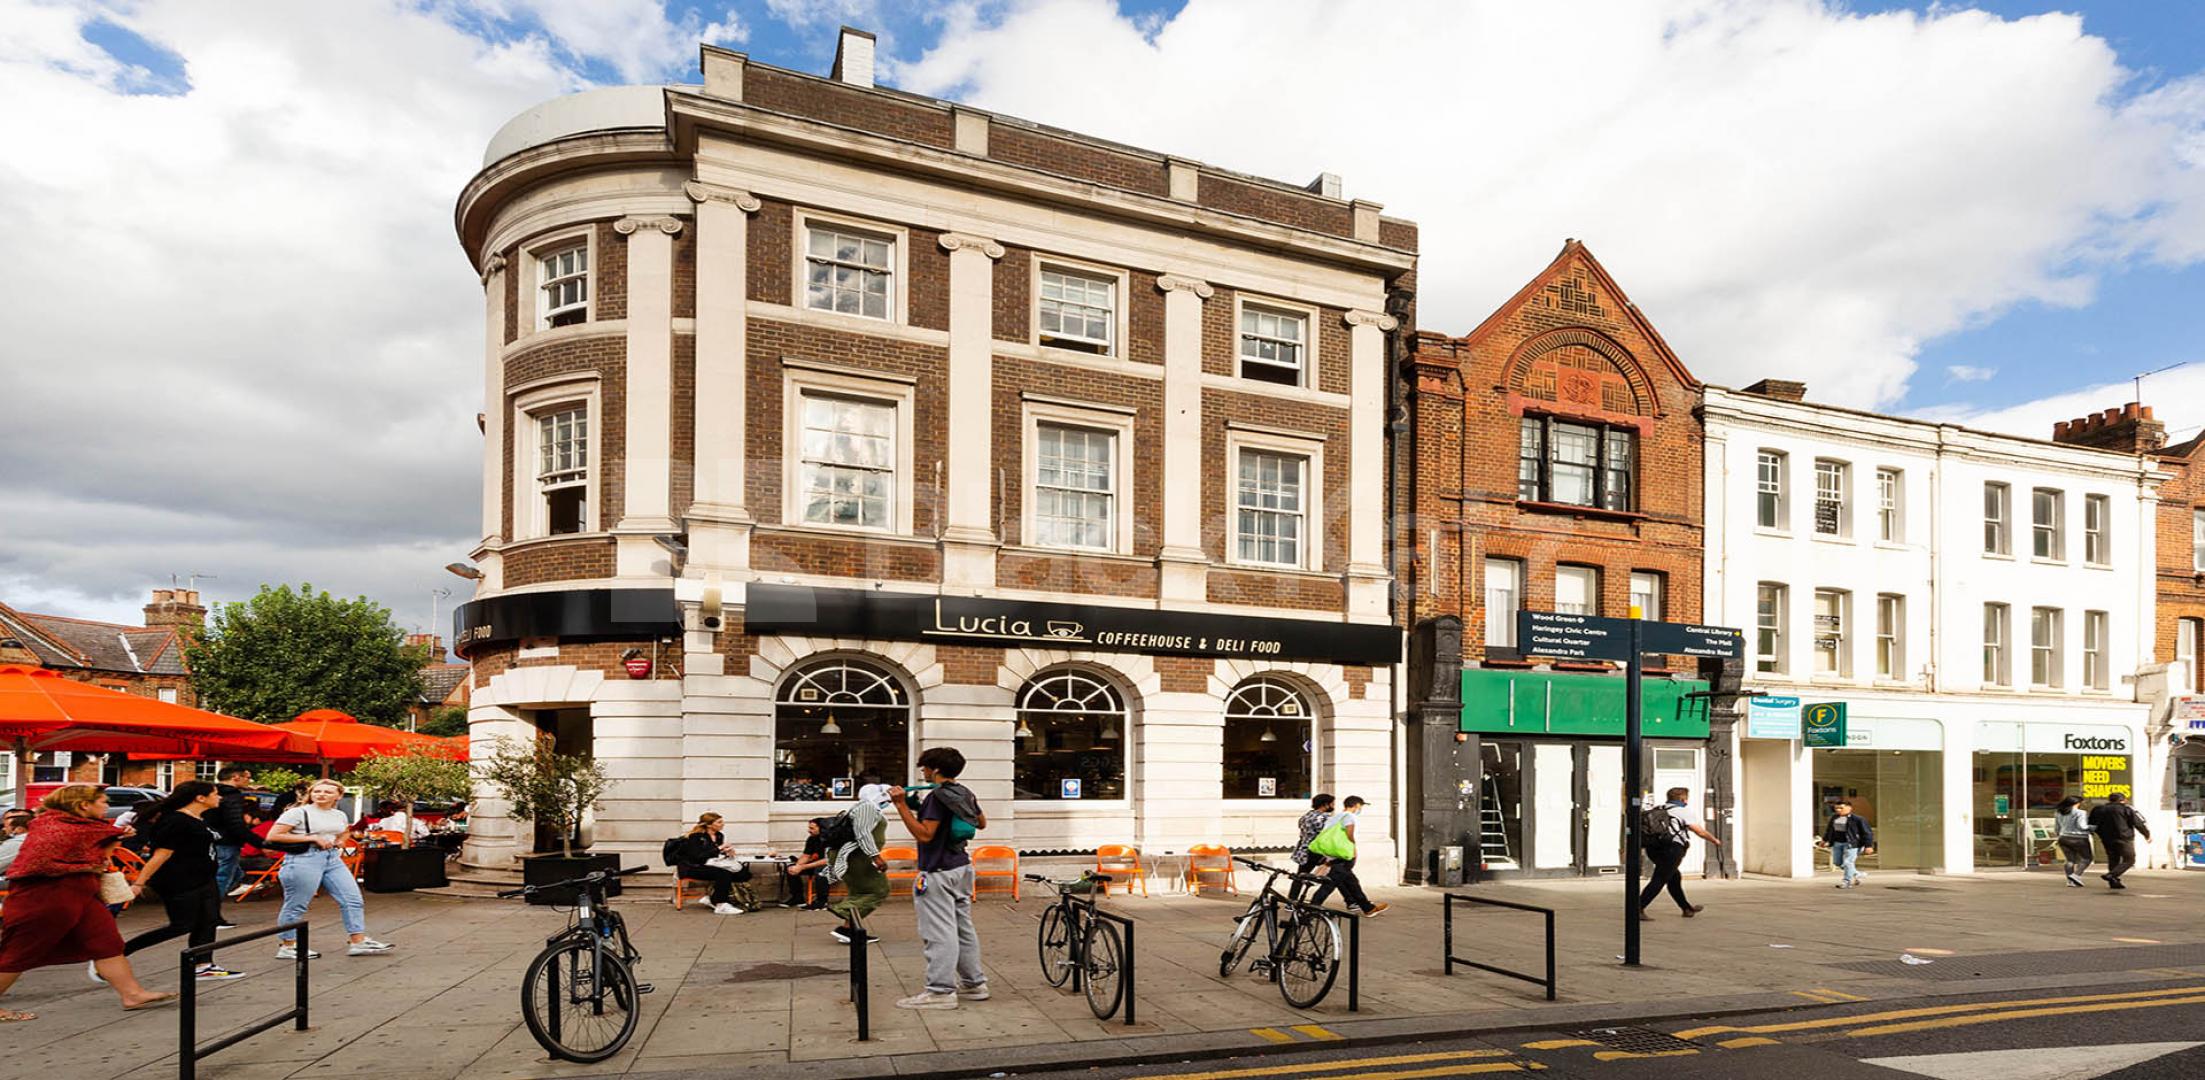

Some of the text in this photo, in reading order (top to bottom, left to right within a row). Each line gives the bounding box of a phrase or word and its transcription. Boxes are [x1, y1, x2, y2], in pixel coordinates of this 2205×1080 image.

[935, 598, 1032, 636] Lucia
[1555, 615, 1577, 623] Green
[474, 625, 492, 639] FOOD
[1532, 625, 1564, 633] Haringey
[1583, 628, 1607, 636] Centre
[1685, 626, 1733, 637] Central Library
[1097, 632, 1282, 654] COFFEEHOUSE & DELI FOOD
[1532, 636, 1591, 646] Cultural Quarter
[1718, 639, 1733, 647] Mall
[1532, 647, 1568, 655] Alexandra
[1684, 647, 1716, 655] Alexandra
[1753, 696, 1797, 706] Dental Surgery
[1816, 709, 1827, 723] F
[1807, 726, 1837, 735] Foxtons
[2064, 733, 2125, 751] Foxtons
[2082, 756, 2127, 771] MOVERS
[2082, 770, 2110, 783] NEED
